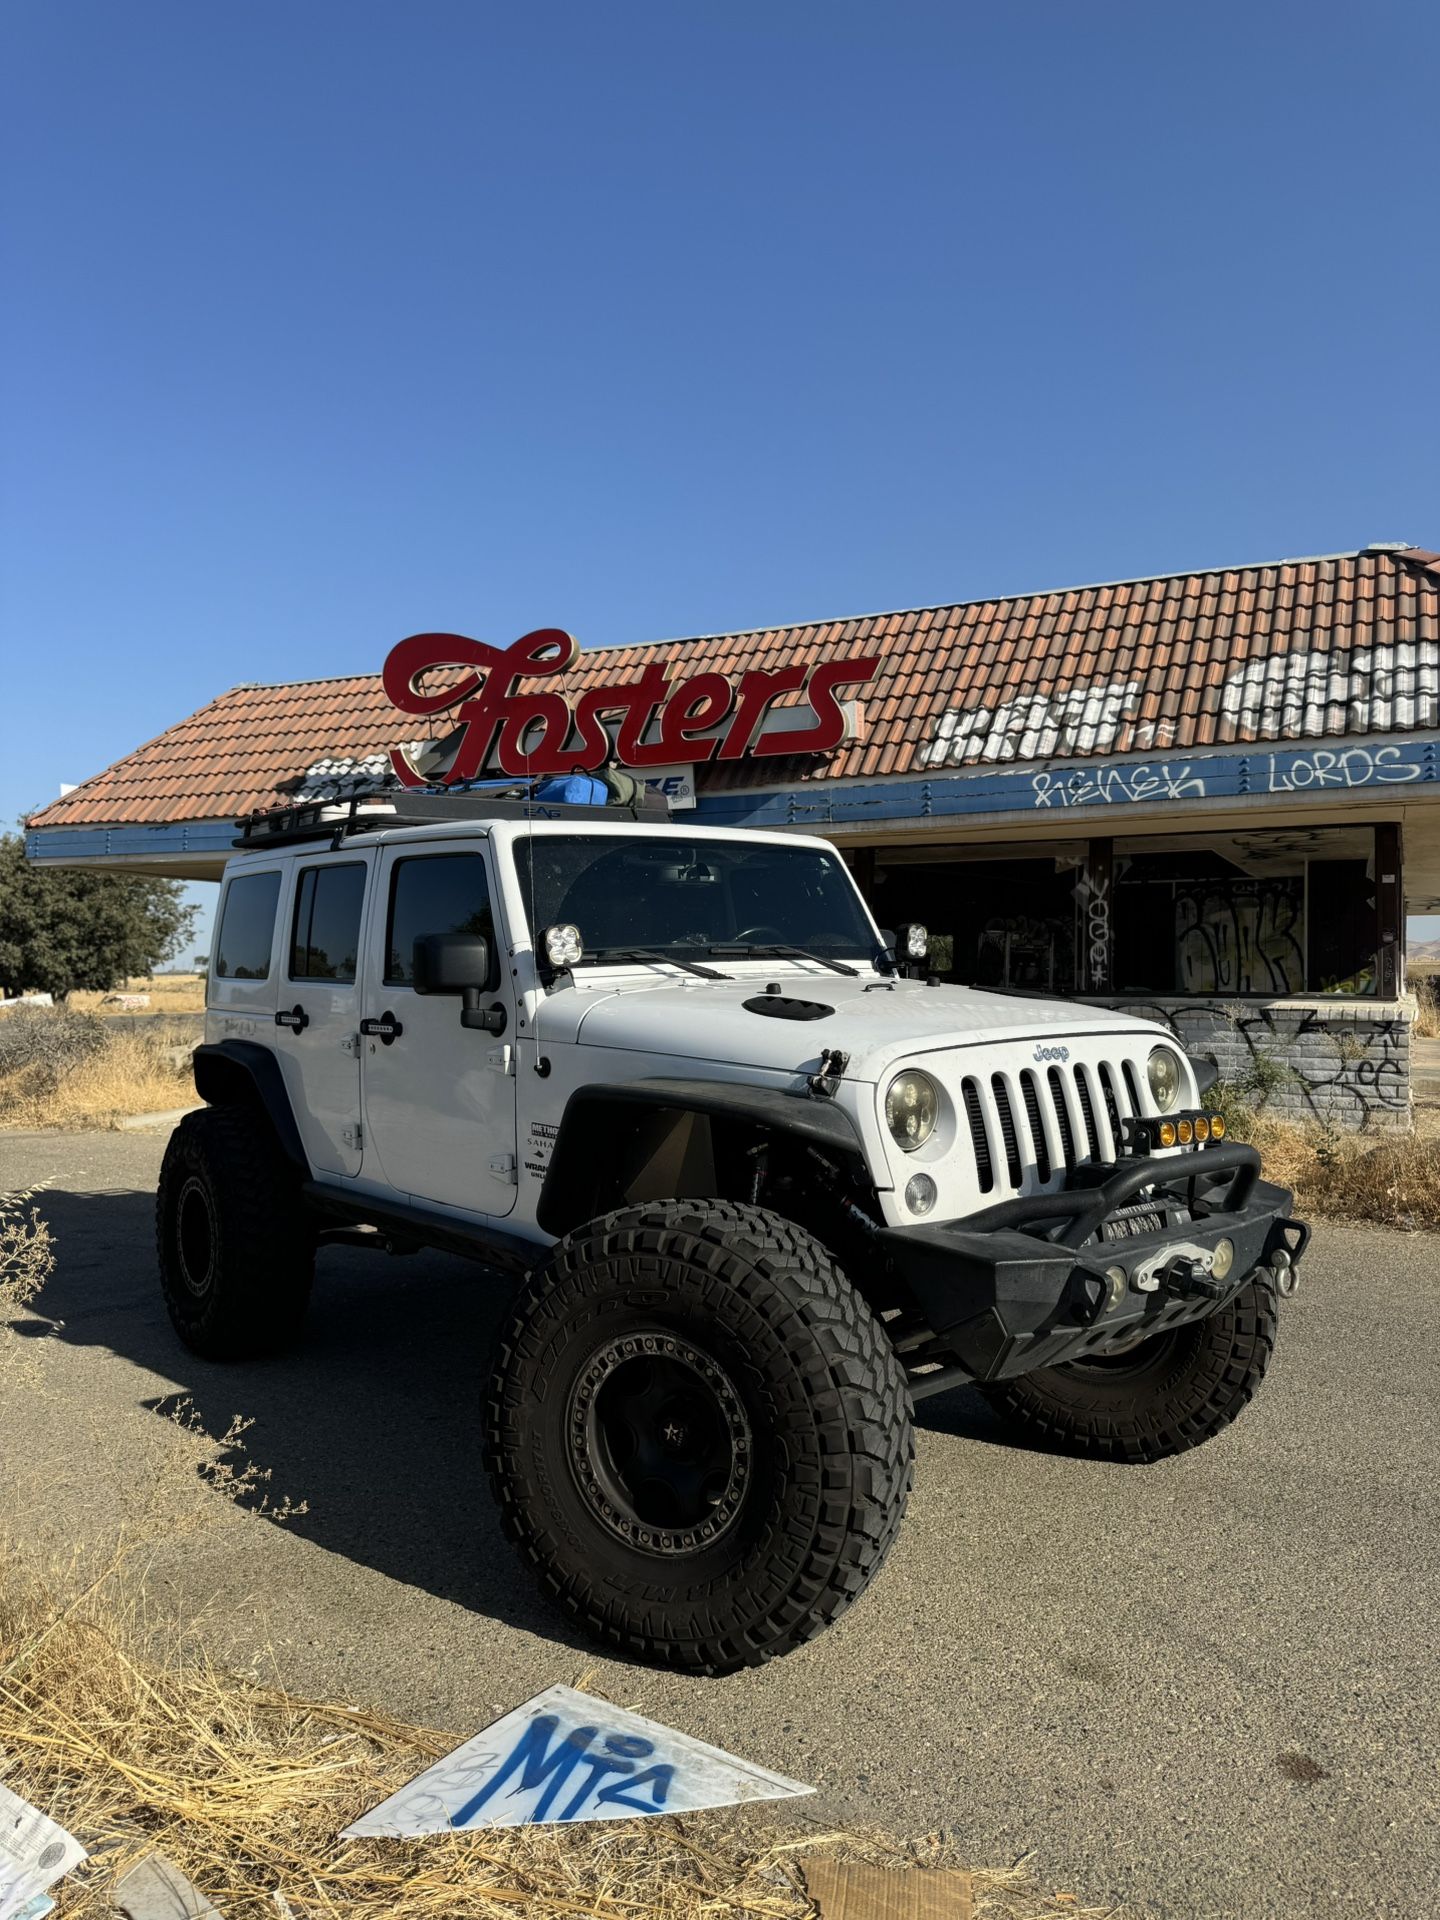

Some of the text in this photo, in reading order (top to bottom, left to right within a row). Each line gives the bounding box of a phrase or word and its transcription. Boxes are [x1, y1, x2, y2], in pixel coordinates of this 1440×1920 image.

[382, 628, 882, 787] Fosters
[1268, 746, 1421, 792] LORDS
[1032, 1044, 1070, 1063] Jeep
[527, 1138, 554, 1149] SAHA
[524, 1162, 547, 1172] WRAN
